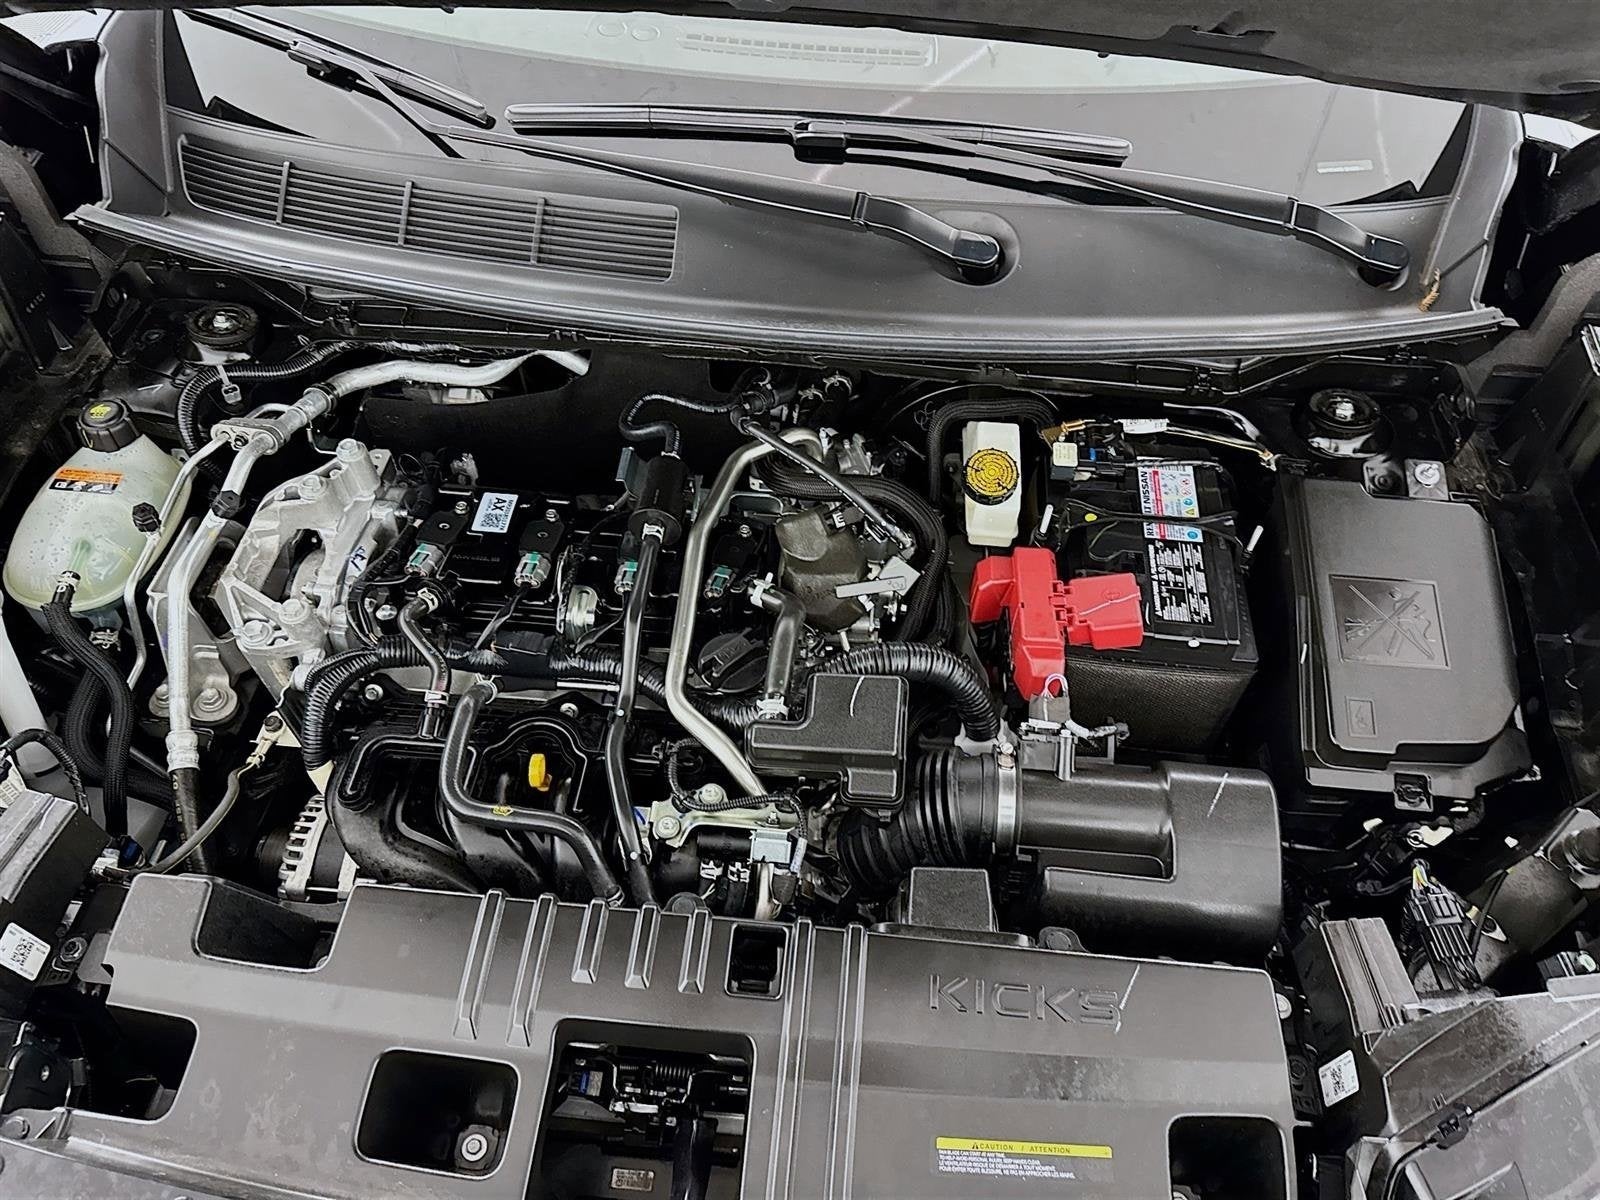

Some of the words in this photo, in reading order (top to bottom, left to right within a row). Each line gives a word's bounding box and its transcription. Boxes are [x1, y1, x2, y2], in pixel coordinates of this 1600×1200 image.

[1140, 471, 1151, 504] NISSAN
[492, 497, 507, 511] AX
[929, 974, 1121, 1026] KICKS
[979, 1143, 1015, 1151] CAUTION
[1029, 1145, 1071, 1154] ATTENTION
